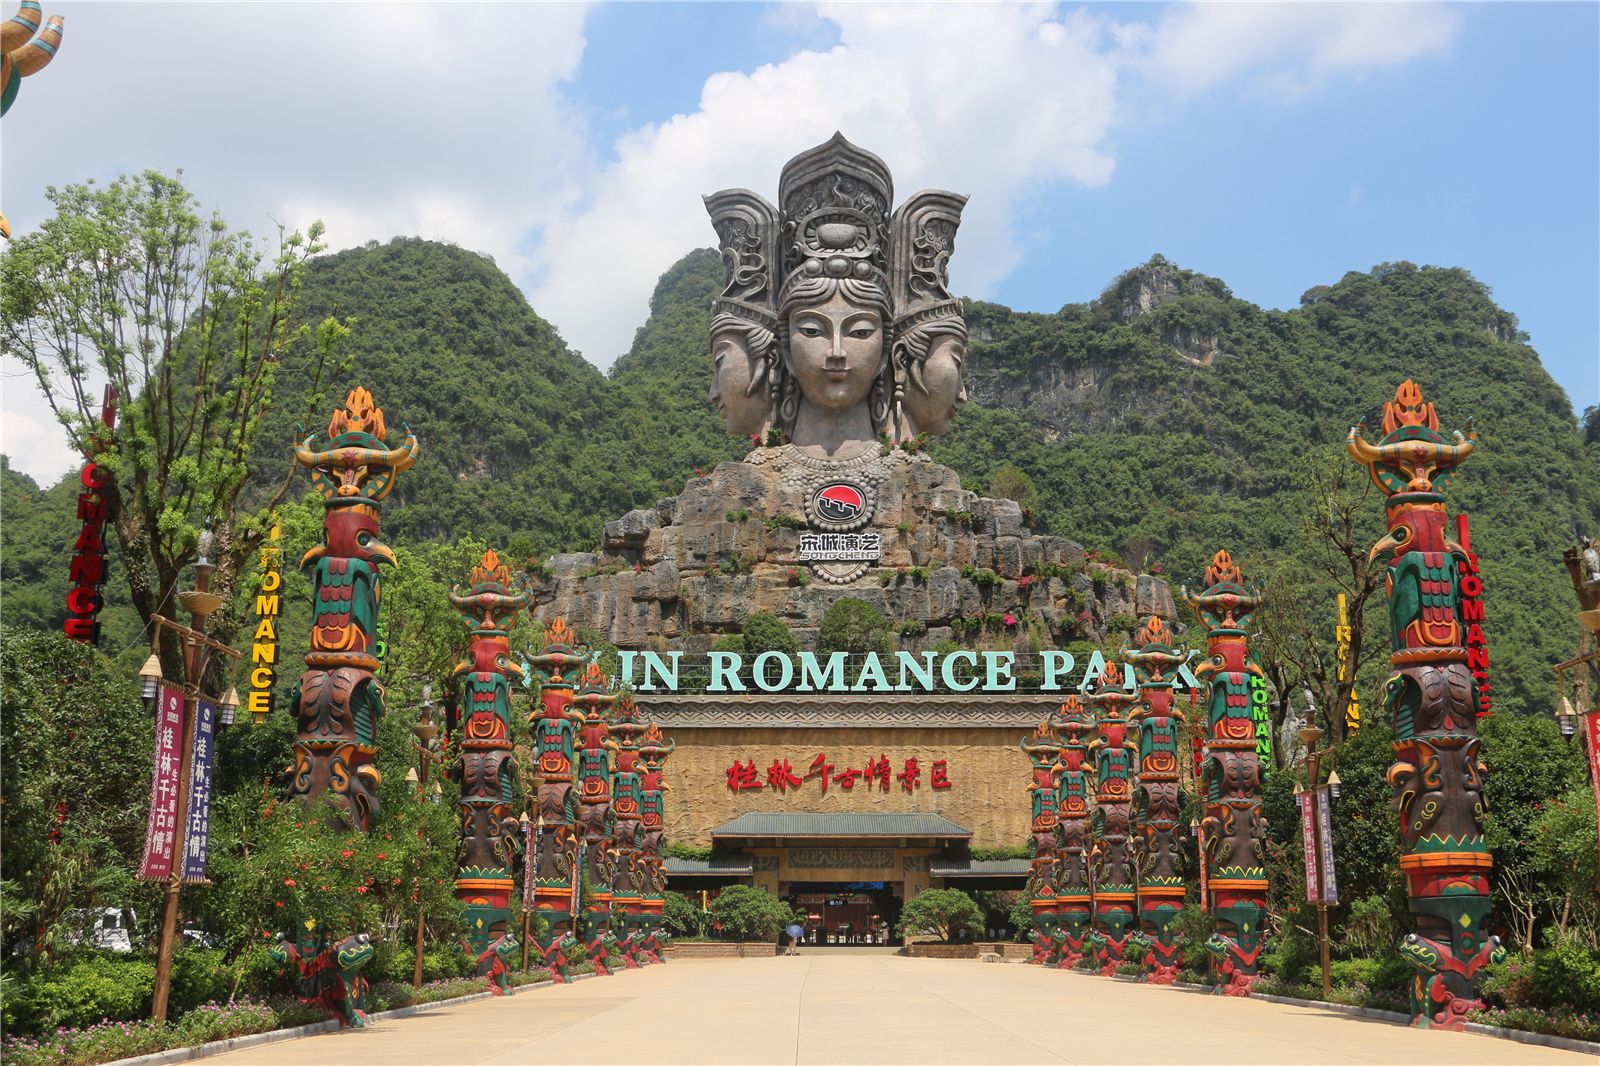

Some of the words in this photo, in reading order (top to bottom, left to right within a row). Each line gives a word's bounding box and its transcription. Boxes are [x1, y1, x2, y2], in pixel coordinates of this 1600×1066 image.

[800, 551, 880, 560] SONGCHENG
[801, 534, 879, 551] 宋城演艺
[706, 650, 1016, 692] ROMANCE
[152, 726, 174, 855] 桂林千古情
[726, 753, 953, 793] 桂林千古情景区
[189, 736, 208, 858] 桂林千古情
